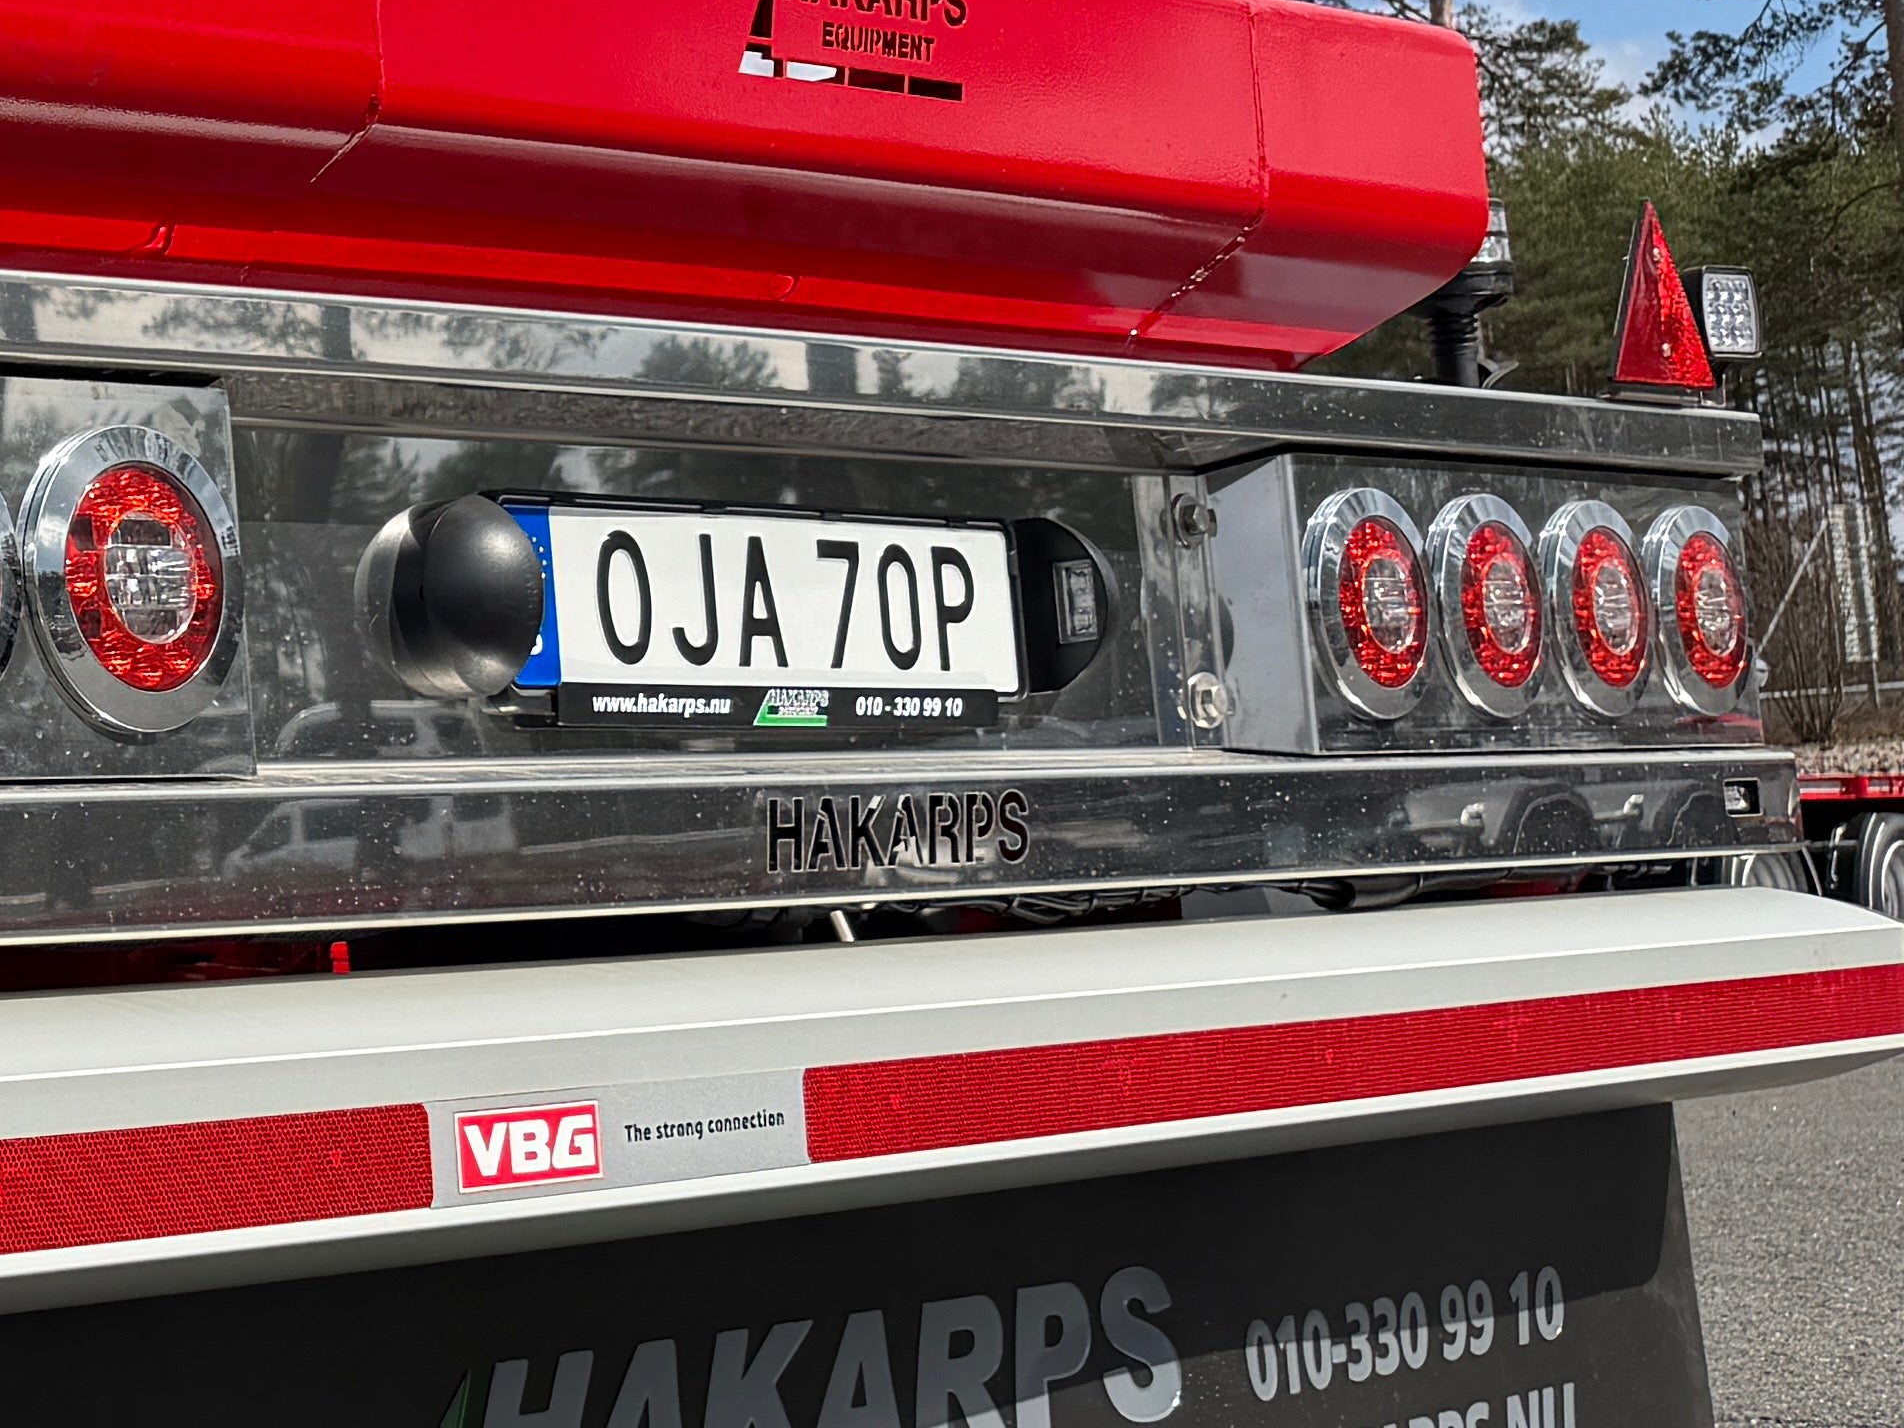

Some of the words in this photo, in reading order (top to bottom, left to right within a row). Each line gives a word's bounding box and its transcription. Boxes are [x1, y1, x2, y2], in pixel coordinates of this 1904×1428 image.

[821, 20, 936, 63] EQUIPMENT
[597, 529, 789, 668] OJA
[816, 538, 975, 672] 70P
[592, 693, 731, 718] www.hakarps.nu
[893, 697, 920, 717] 330
[923, 697, 942, 717] 99
[945, 697, 963, 717] 10
[767, 789, 1031, 873] HAKARPS
[462, 1112, 597, 1178] VBG
[624, 1121, 652, 1143] The
[656, 1118, 704, 1140] strong
[707, 1108, 786, 1135] connection
[1246, 1292, 1429, 1403] 010-330
[1439, 1279, 1496, 1361] 99
[1511, 1265, 1566, 1342] 10
